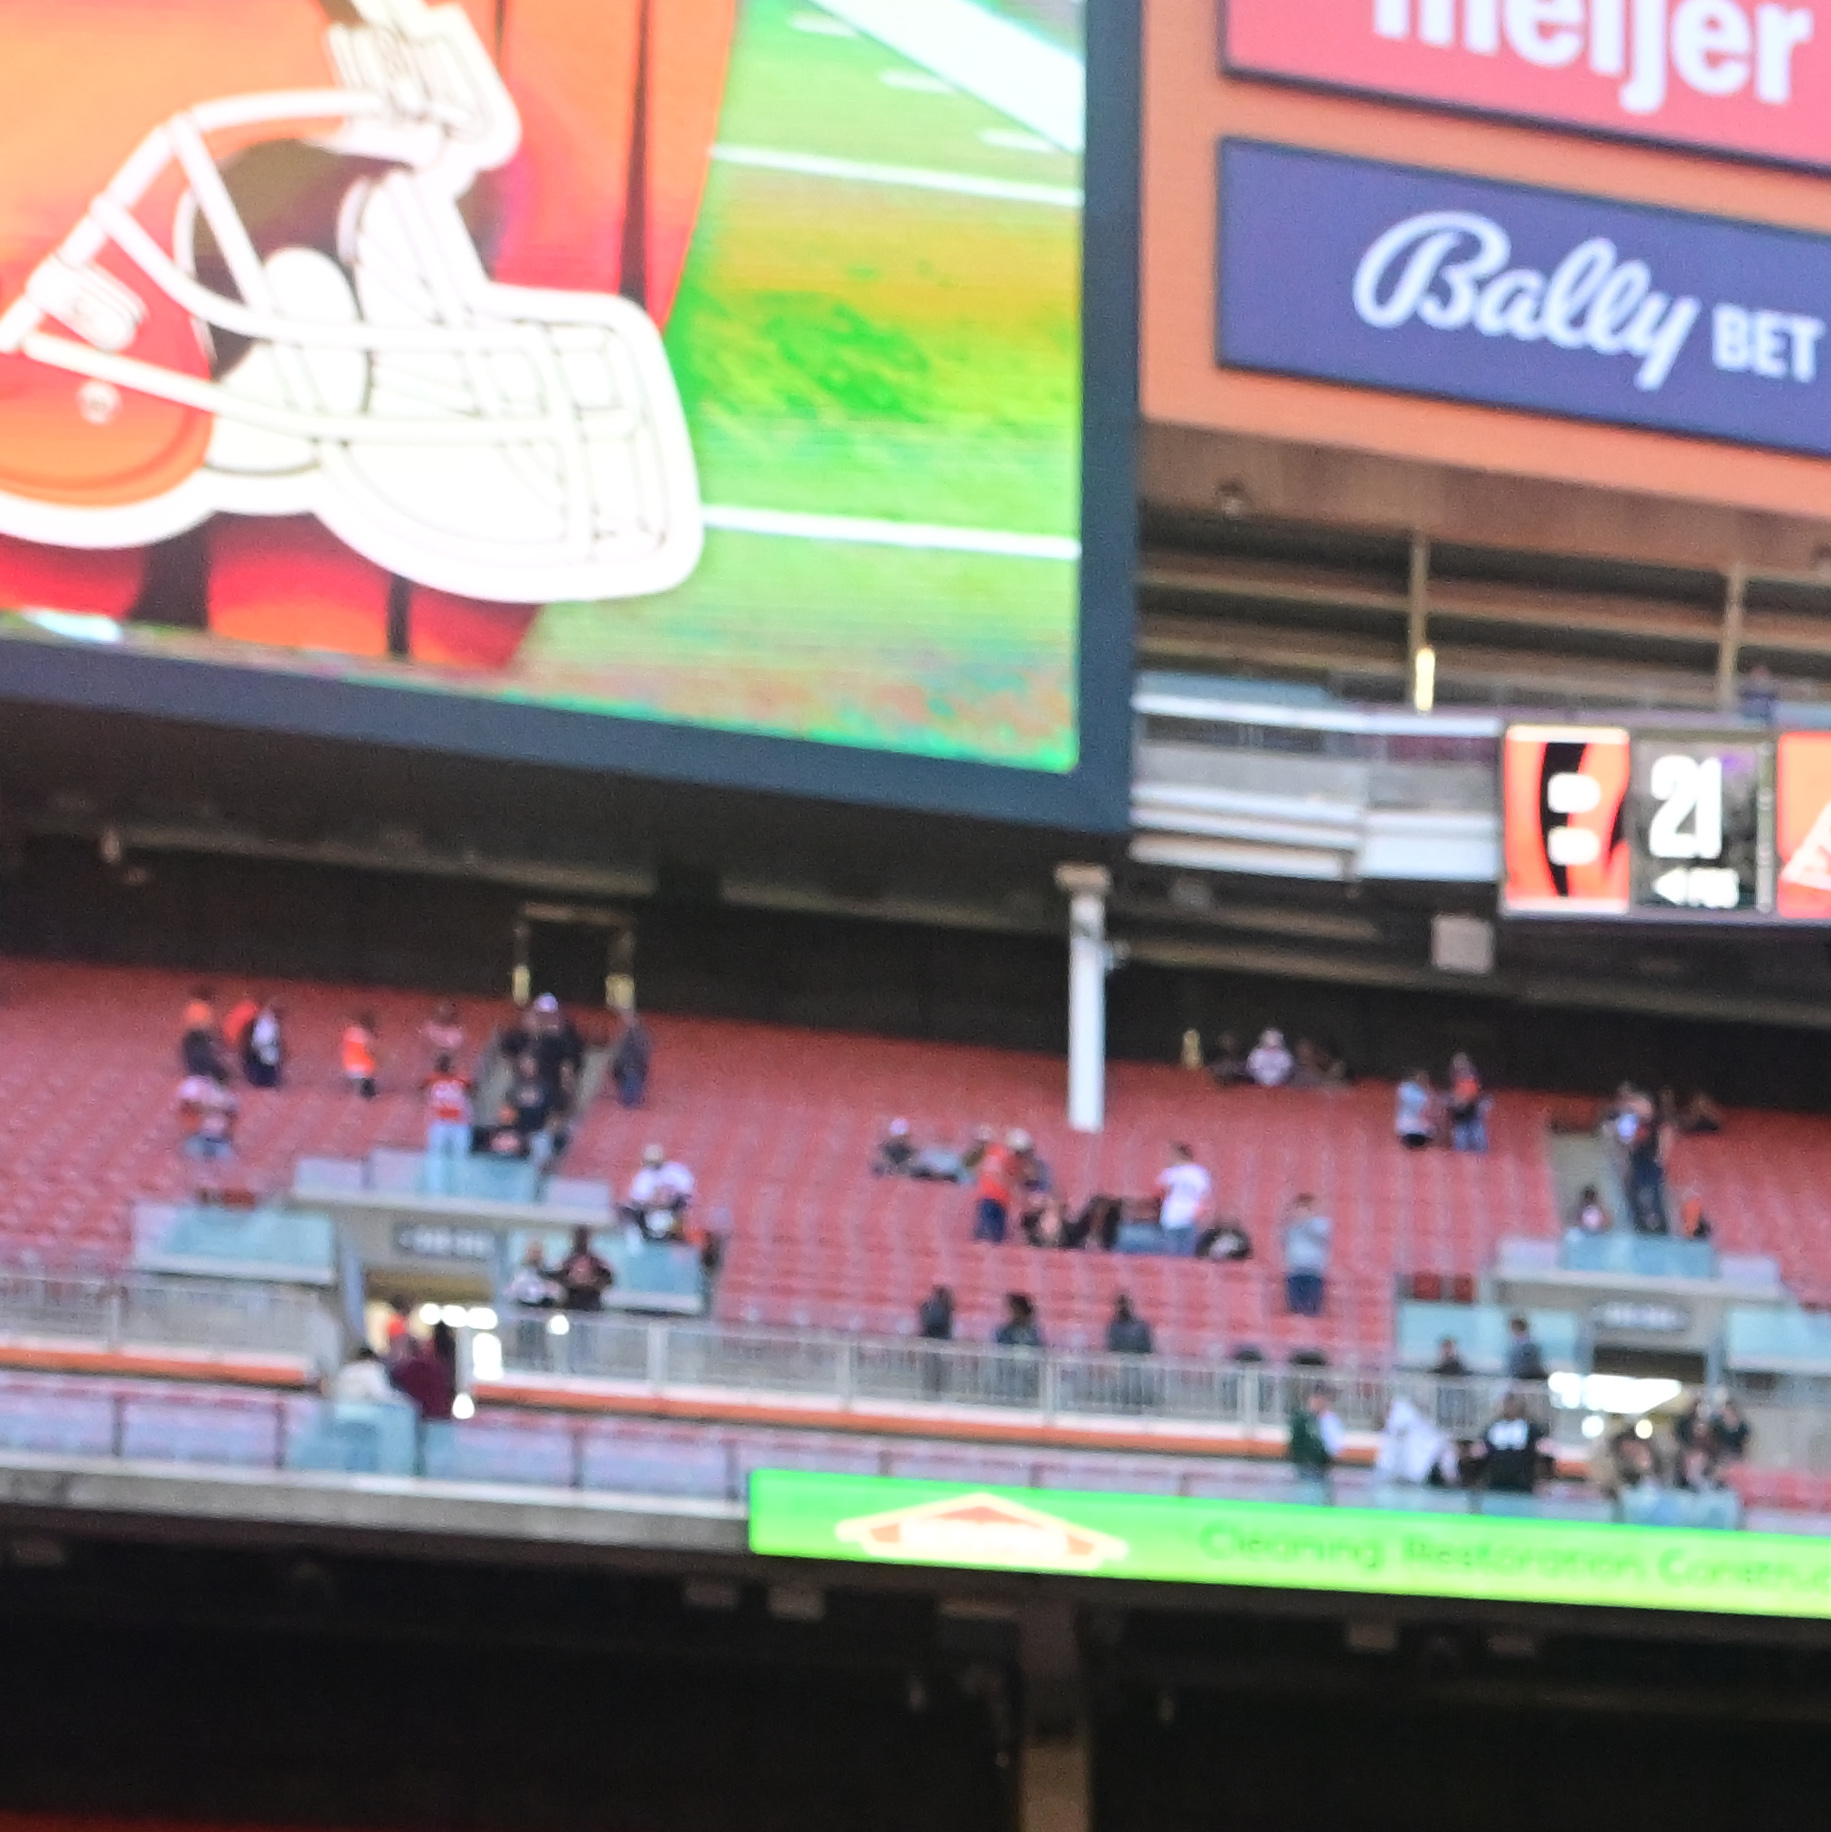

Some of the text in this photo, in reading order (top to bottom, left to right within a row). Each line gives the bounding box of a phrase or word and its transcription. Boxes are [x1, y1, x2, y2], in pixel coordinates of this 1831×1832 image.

[1353, 210, 1825, 391] Bally BET
[1647, 755, 1723, 859] 21
